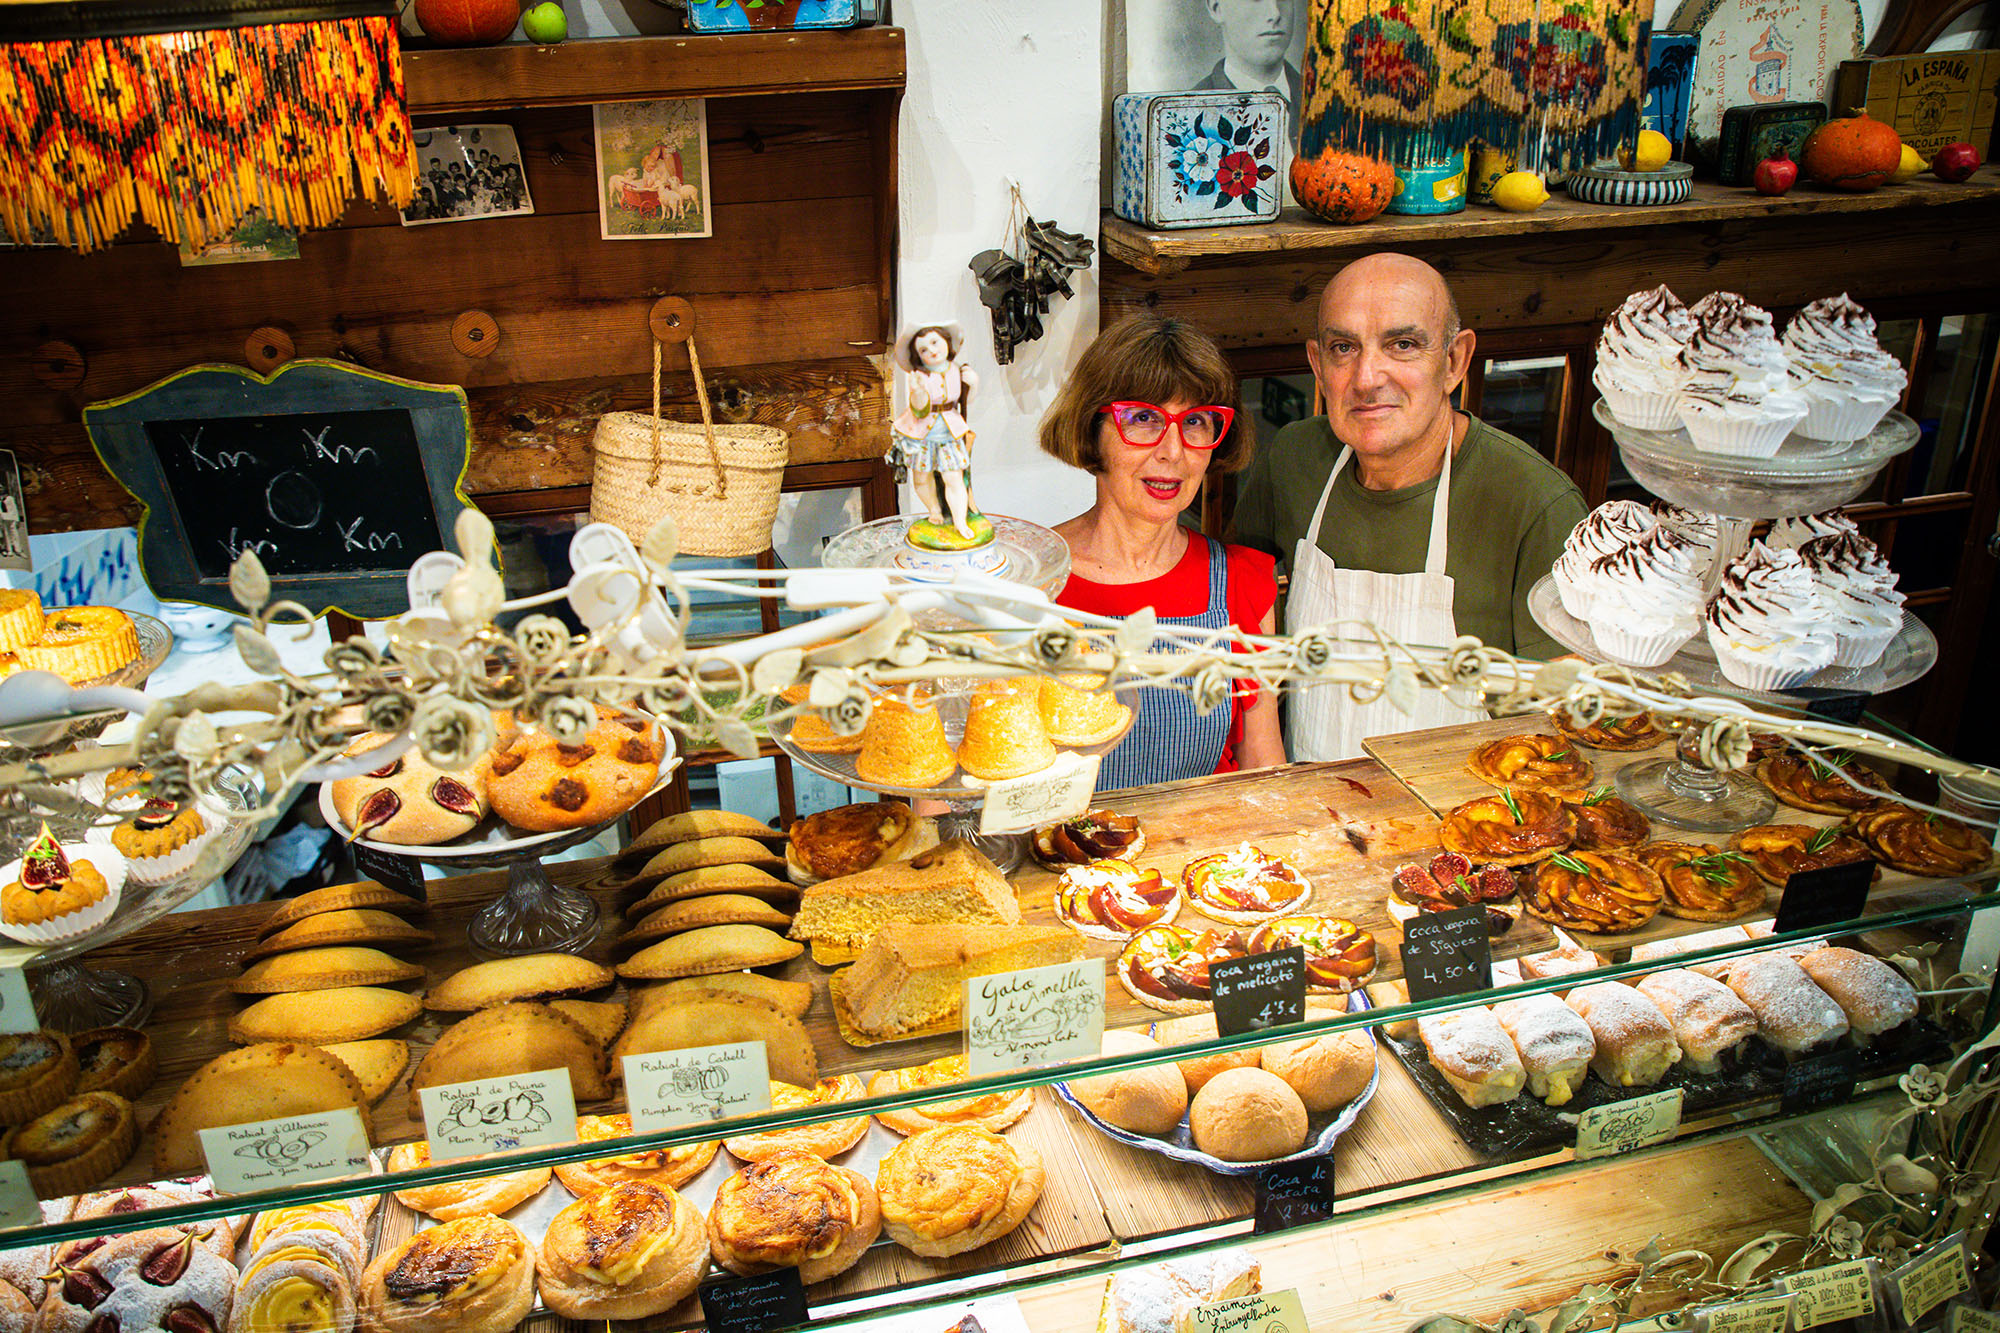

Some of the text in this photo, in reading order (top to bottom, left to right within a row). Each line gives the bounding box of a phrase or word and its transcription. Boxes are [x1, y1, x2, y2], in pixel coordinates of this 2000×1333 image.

[1820, 22, 1828, 31] LA
[1718, 30, 1726, 46] EN
[1904, 60, 1970, 87] LA ESPAÑA
[180, 425, 380, 471] Km Km
[218, 515, 403, 561] Km Km
[1408, 944, 1422, 955] de
[1249, 956, 1297, 975] vegana
[1216, 981, 1230, 996] de
[1055, 1030, 1078, 1041] Cake
[688, 1056, 702, 1067] de
[708, 1048, 748, 1064] Cabell
[489, 1084, 503, 1096] de
[509, 1080, 547, 1091] Pruna
[1655, 1095, 1679, 1104] Crema
[641, 1105, 682, 1117] Pumpkin
[687, 1102, 710, 1114] Jam
[448, 1135, 474, 1145] Plum
[479, 1131, 503, 1144] Jam
[1268, 1165, 1327, 1191] Coca de
[1264, 1185, 1320, 1213] patata
[1790, 1275, 1816, 1290] Galletes
[749, 1295, 786, 1306] Crema
[1714, 1312, 1738, 1326] Galletes
